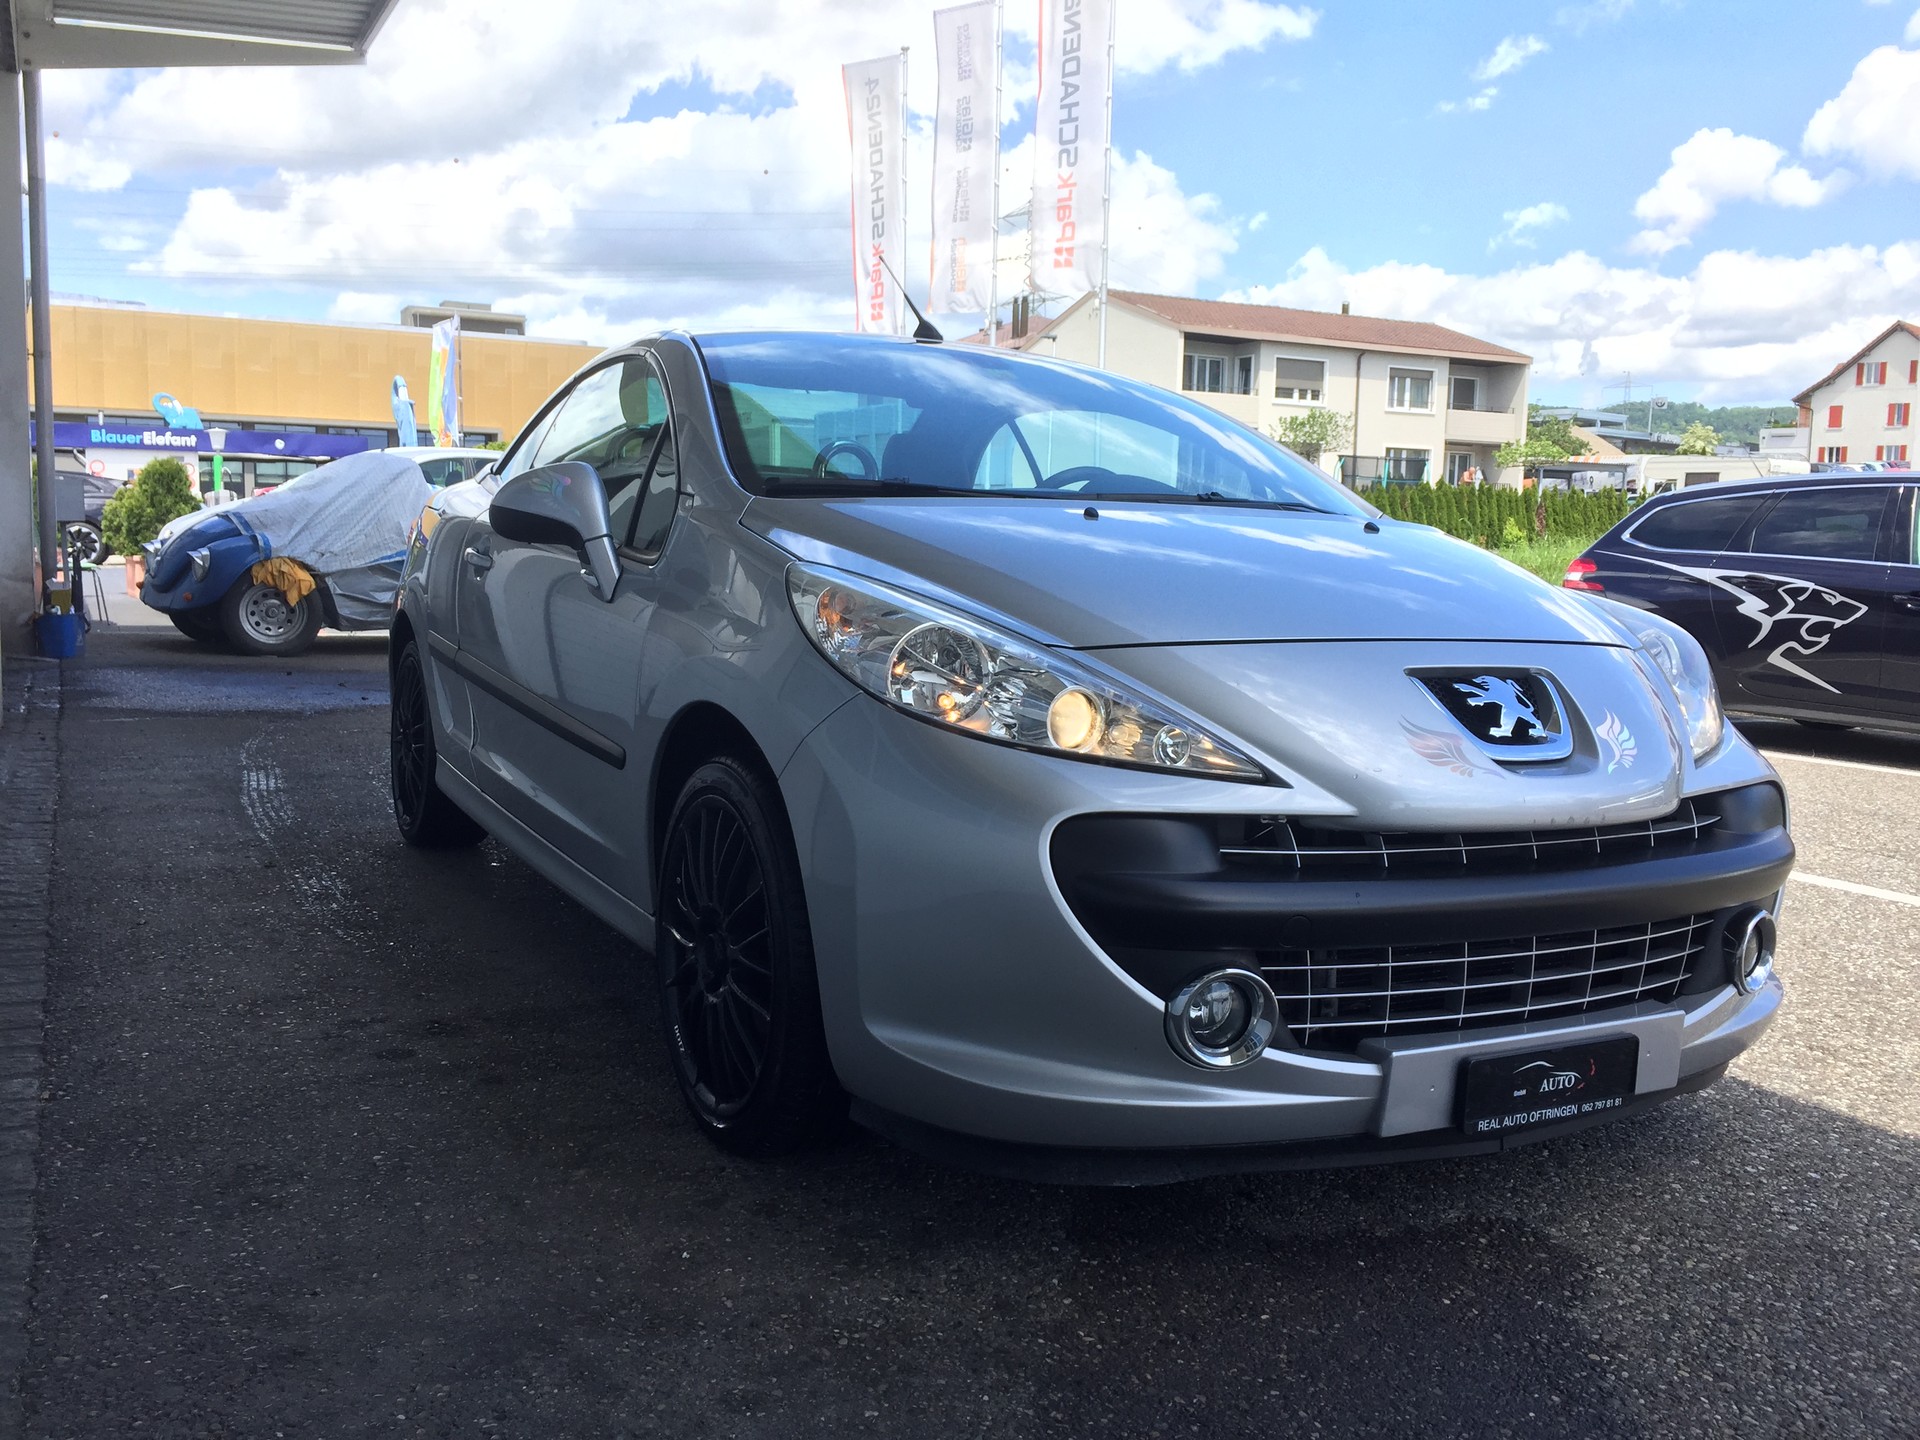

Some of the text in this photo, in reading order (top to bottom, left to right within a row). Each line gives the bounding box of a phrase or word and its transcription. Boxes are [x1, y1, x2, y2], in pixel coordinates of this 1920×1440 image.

[1539, 1074, 1576, 1093] AUTO
[1478, 1097, 1622, 1131] REAL AUTO OFTRINGEN 062 797 81 81
